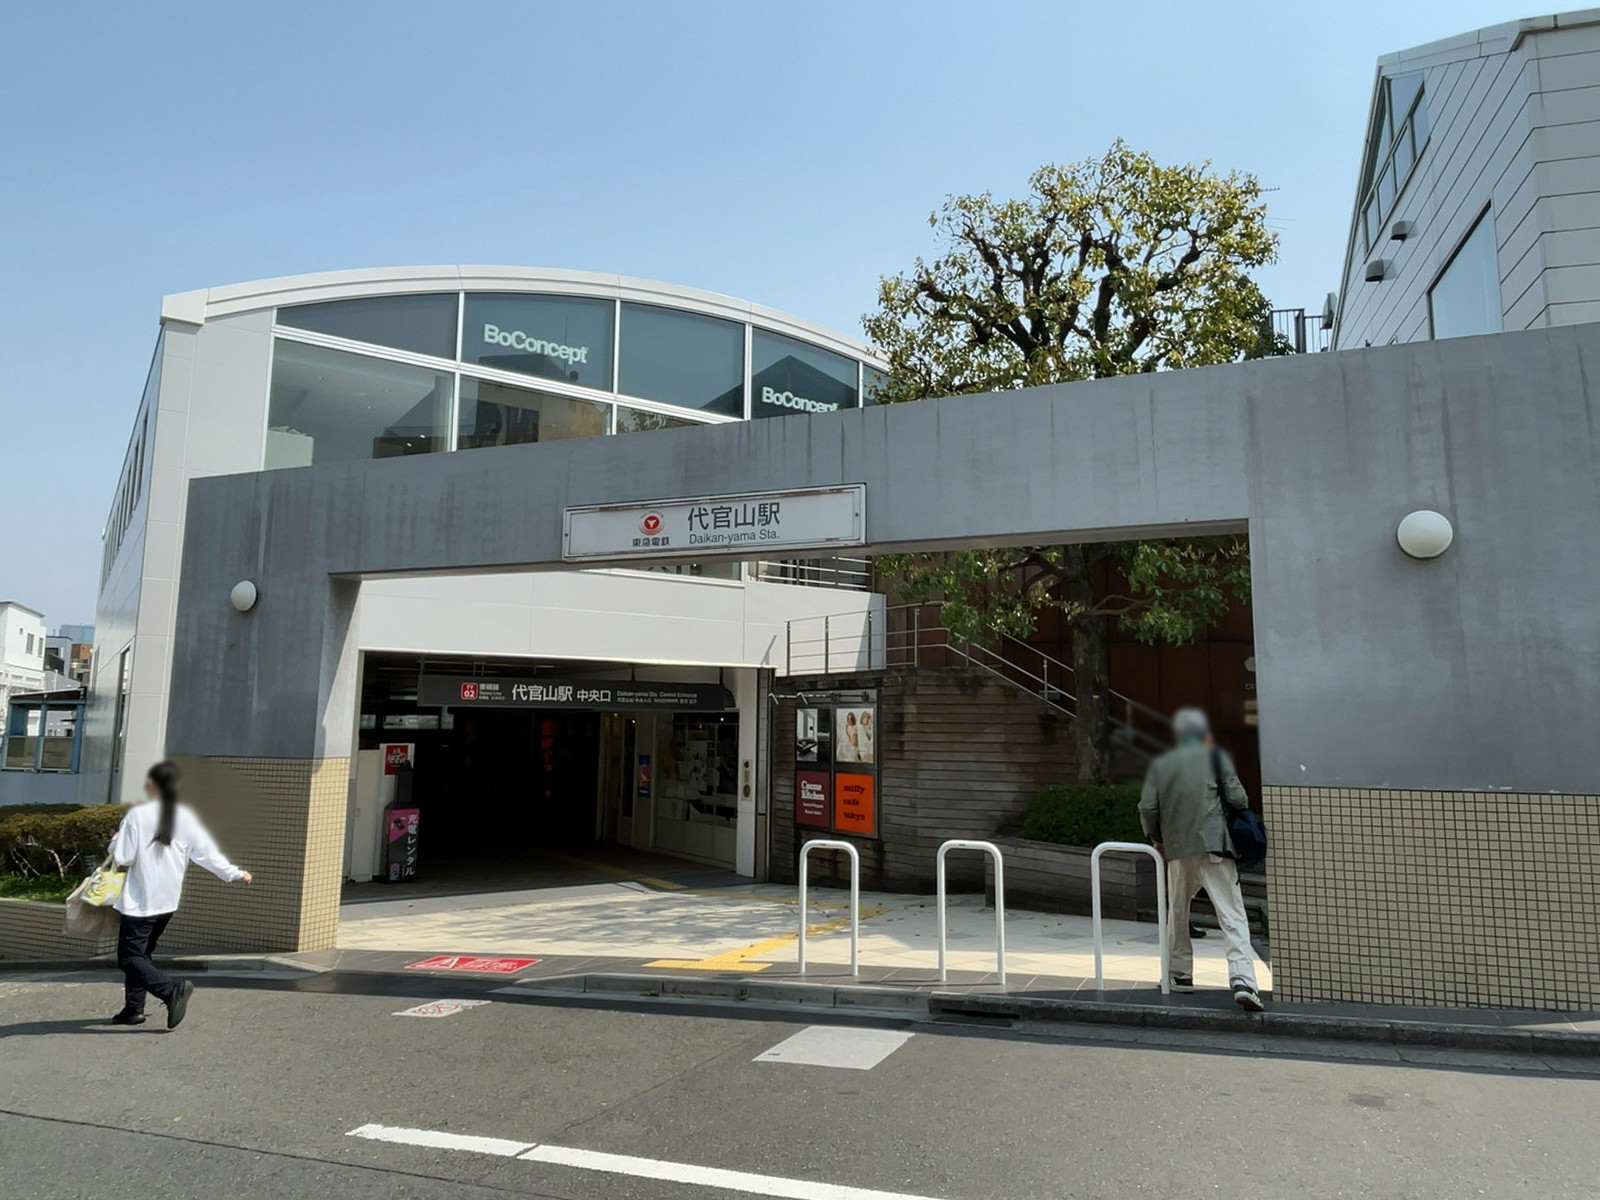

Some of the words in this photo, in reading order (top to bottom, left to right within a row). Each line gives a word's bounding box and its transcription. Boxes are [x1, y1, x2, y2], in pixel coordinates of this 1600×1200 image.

[484, 323, 589, 365] BoConcept
[688, 502, 781, 531] 代官山駅
[632, 536, 670, 547] 東急電鉄
[689, 533, 756, 544] Daikan-yama
[759, 528, 780, 540] Sta.
[464, 690, 475, 698] 02
[512, 684, 573, 702] 代官山駅
[577, 688, 611, 702] 中央口
[404, 814, 418, 875] 充電レンタル
